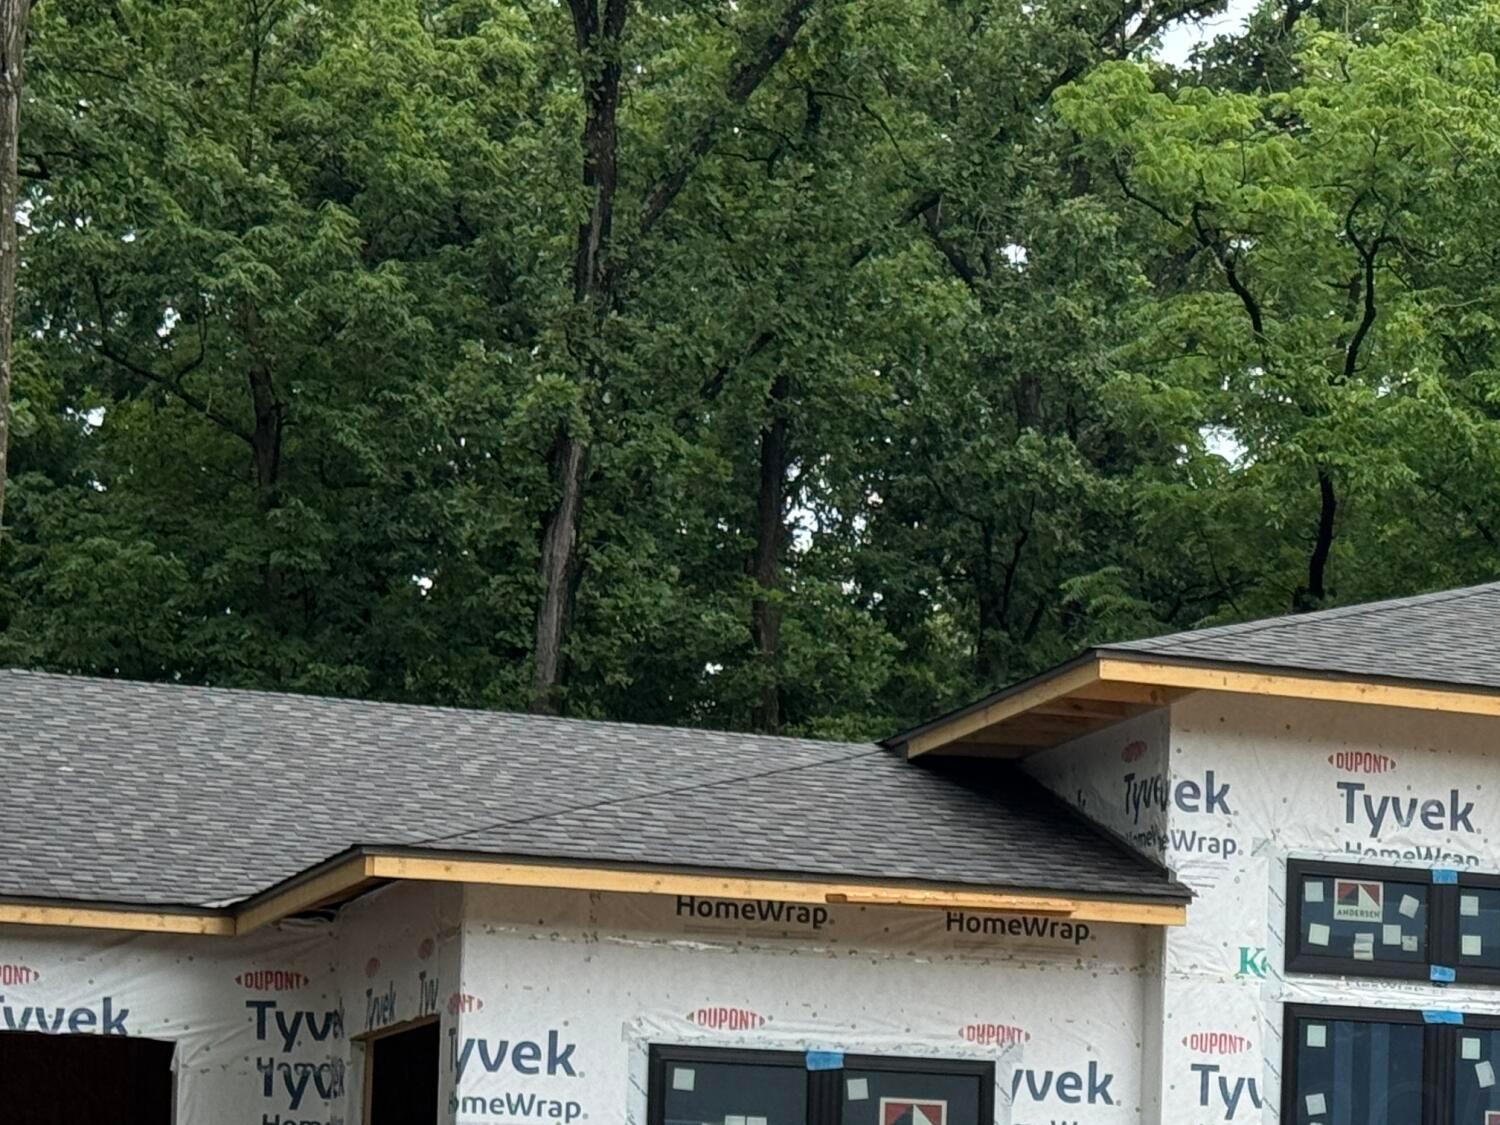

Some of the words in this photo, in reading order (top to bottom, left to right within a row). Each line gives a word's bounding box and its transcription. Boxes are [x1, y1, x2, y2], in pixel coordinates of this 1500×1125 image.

[1336, 752, 1390, 774] DUPONT
[1336, 781, 1475, 838] Tyvek
[676, 895, 828, 929] HomeWrap
[946, 911, 1090, 945] HomeWrap
[244, 971, 302, 991] DUPONT
[697, 1008, 757, 1030] DUPONT
[966, 1023, 1024, 1045] DUPONT
[1190, 1033, 1246, 1054] DUPONT
